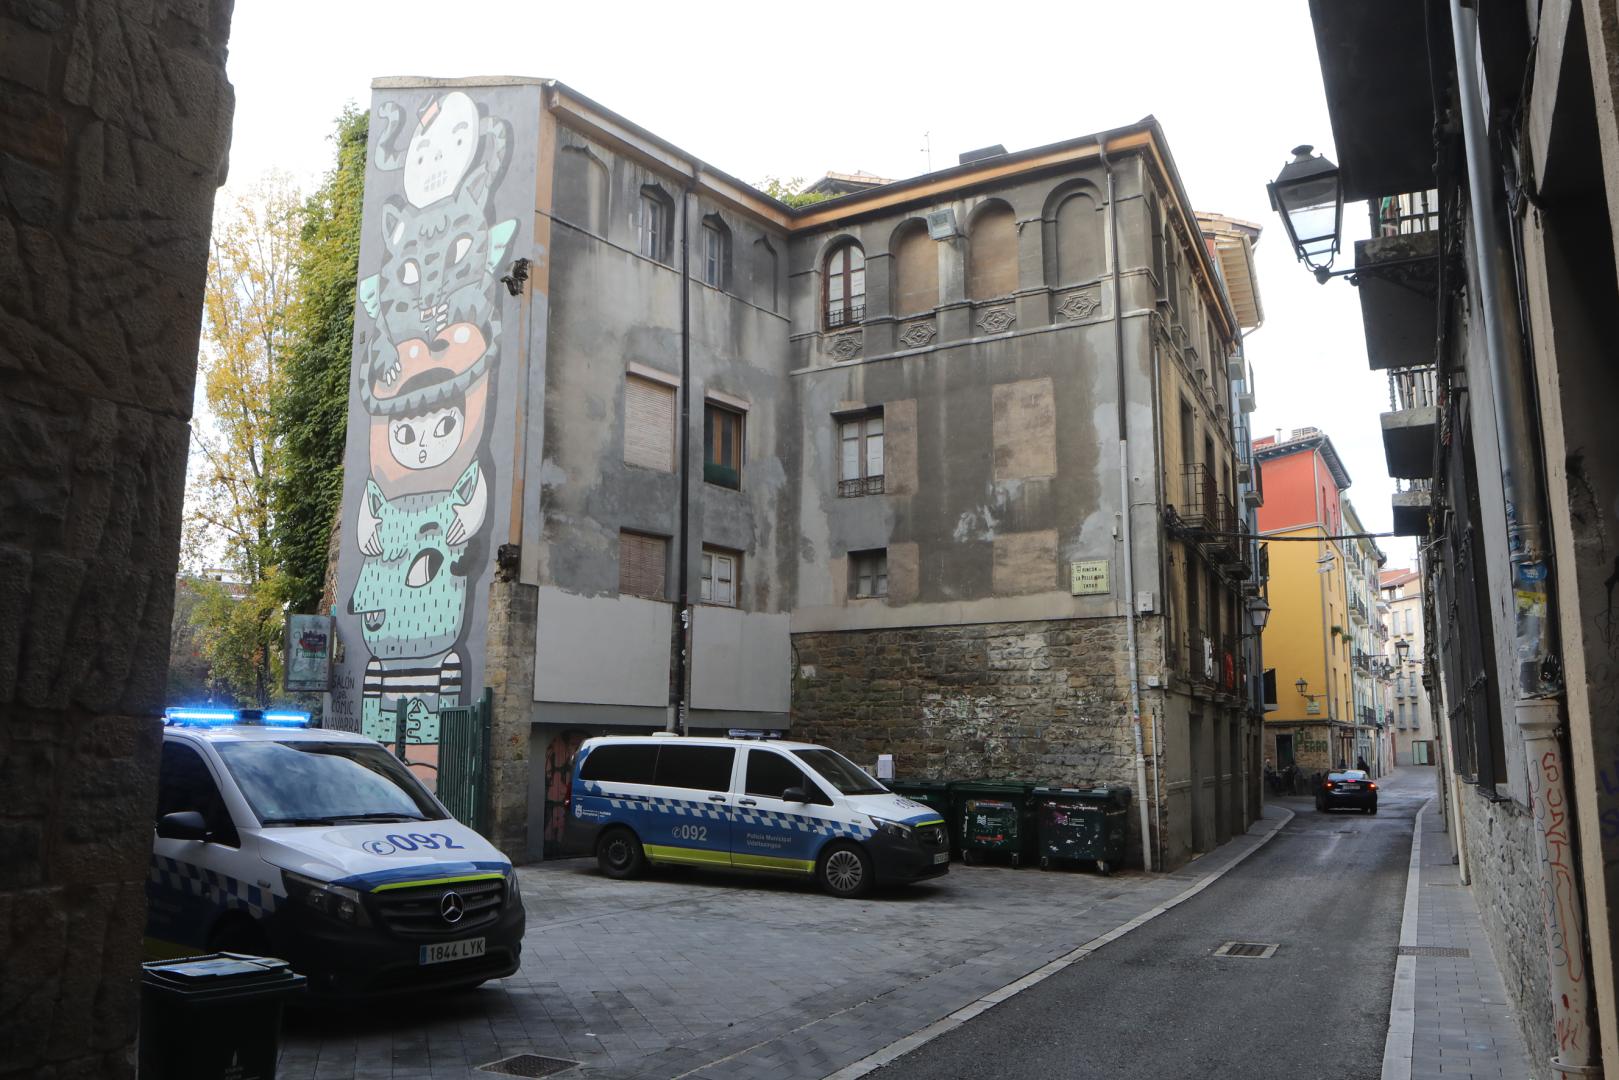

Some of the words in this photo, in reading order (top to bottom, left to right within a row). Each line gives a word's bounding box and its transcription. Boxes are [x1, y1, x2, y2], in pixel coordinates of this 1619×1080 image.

[324, 715, 360, 733] NAVARRA
[682, 824, 708, 841] 092
[386, 833, 465, 851] 092
[431, 945, 458, 961] 1844
[462, 940, 484, 956] LYK
